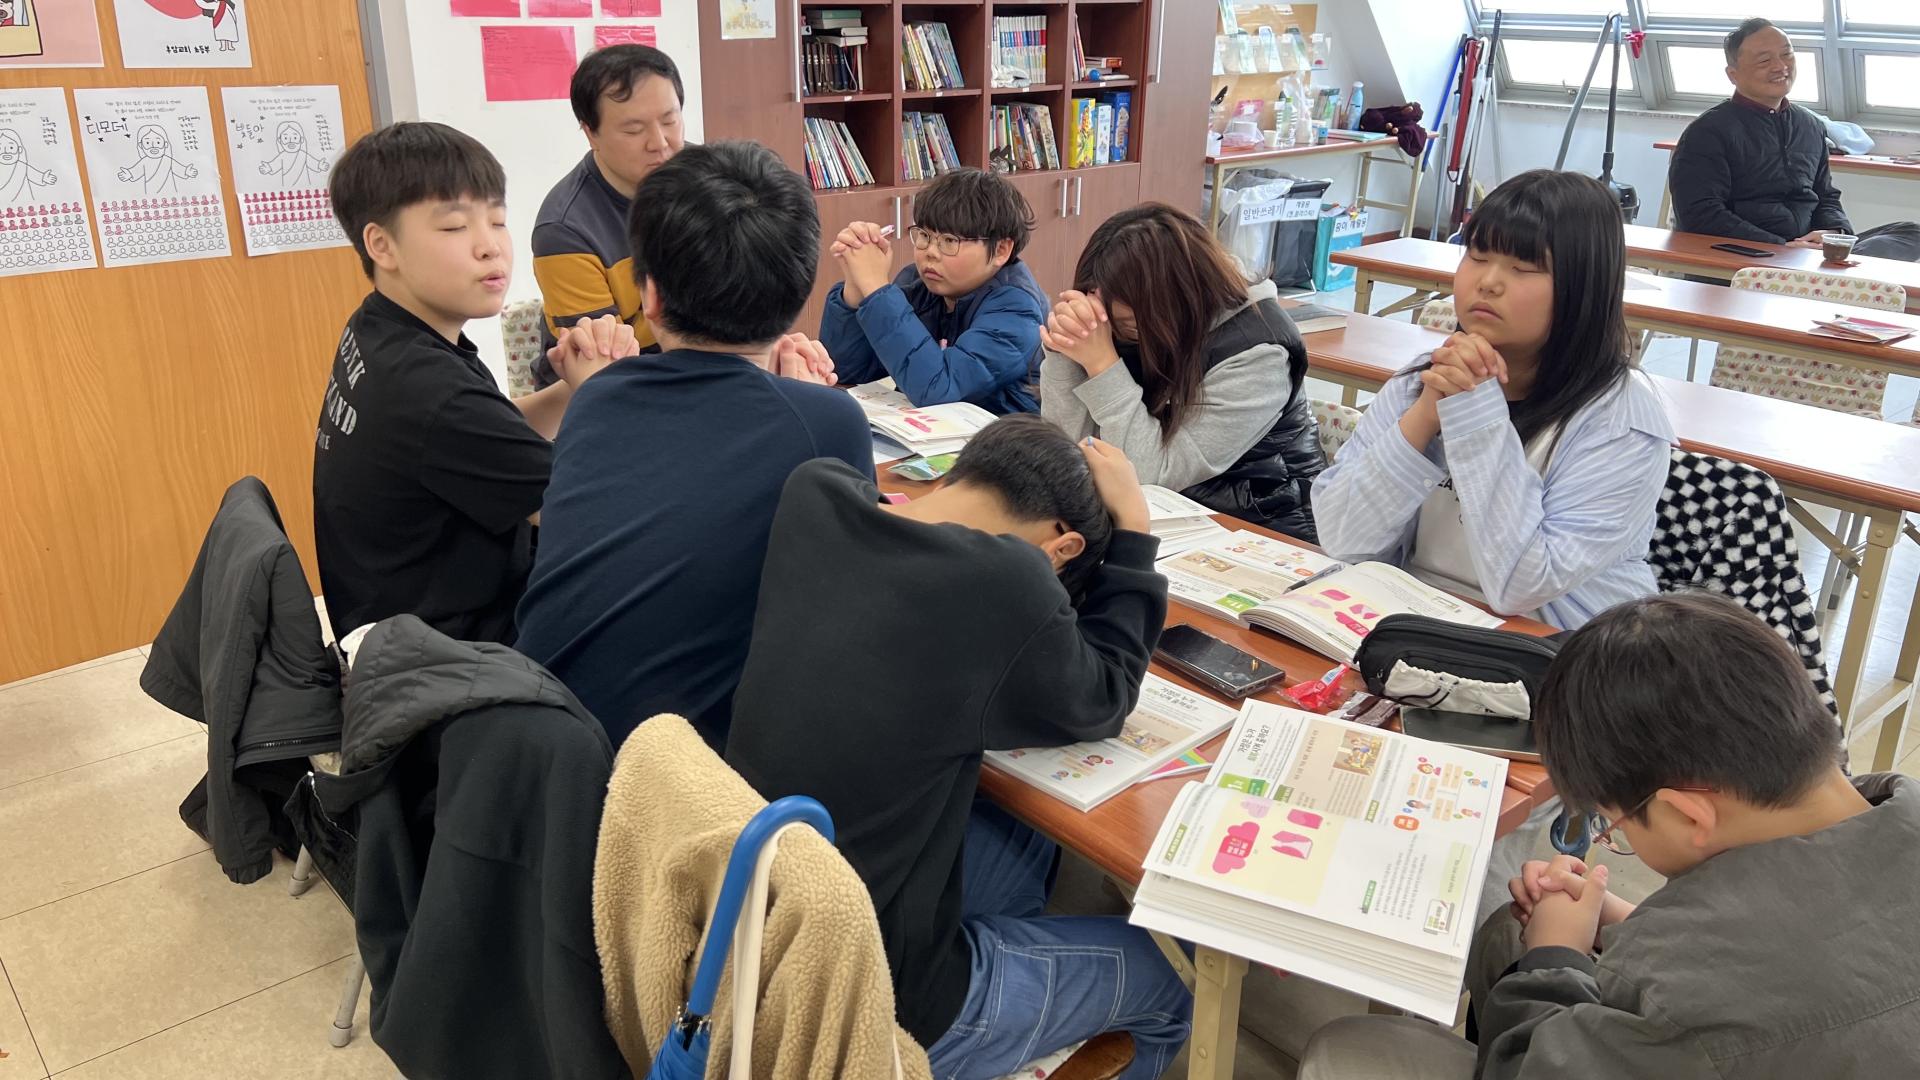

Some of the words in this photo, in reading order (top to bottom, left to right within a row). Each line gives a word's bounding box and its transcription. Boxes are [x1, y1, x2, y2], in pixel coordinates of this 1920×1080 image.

[194, 45, 211, 54] 초등부
[87, 121, 128, 135] 디모데
[1243, 203, 1282, 221] 일반쓰레기
